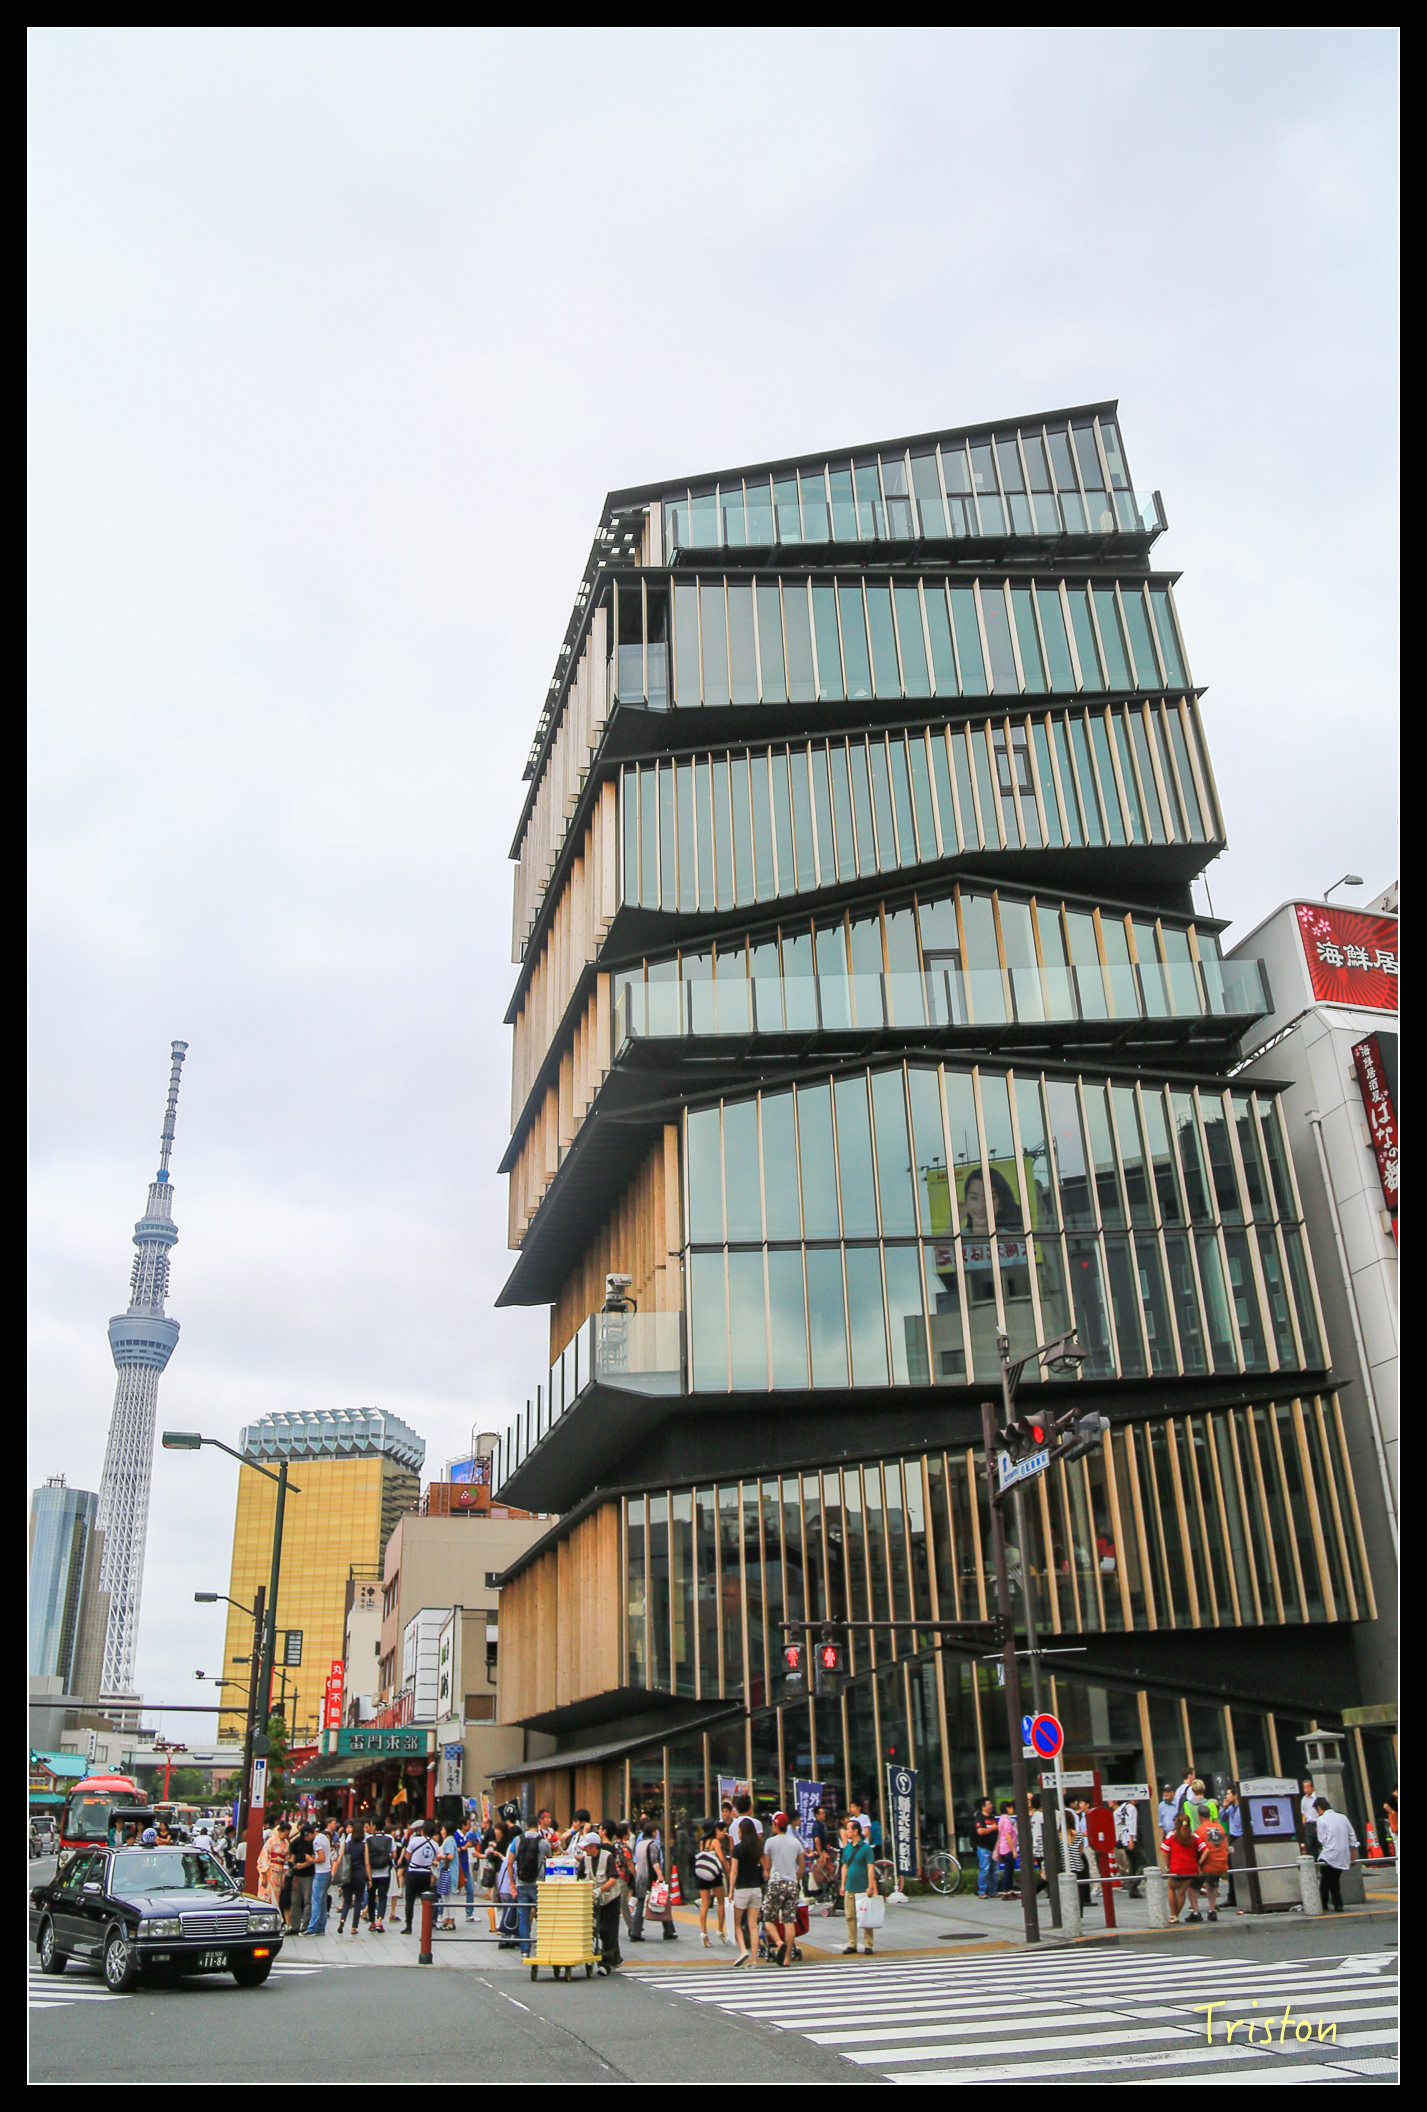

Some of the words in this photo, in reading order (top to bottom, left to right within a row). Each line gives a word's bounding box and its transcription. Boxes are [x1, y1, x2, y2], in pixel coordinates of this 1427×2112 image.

[1316, 941, 1398, 975] 海鮮居
[1360, 1044, 1382, 1103] 海鮮居酒屋
[350, 1734, 418, 1750] 雷門東部
[204, 1956, 227, 1967] 11-84
